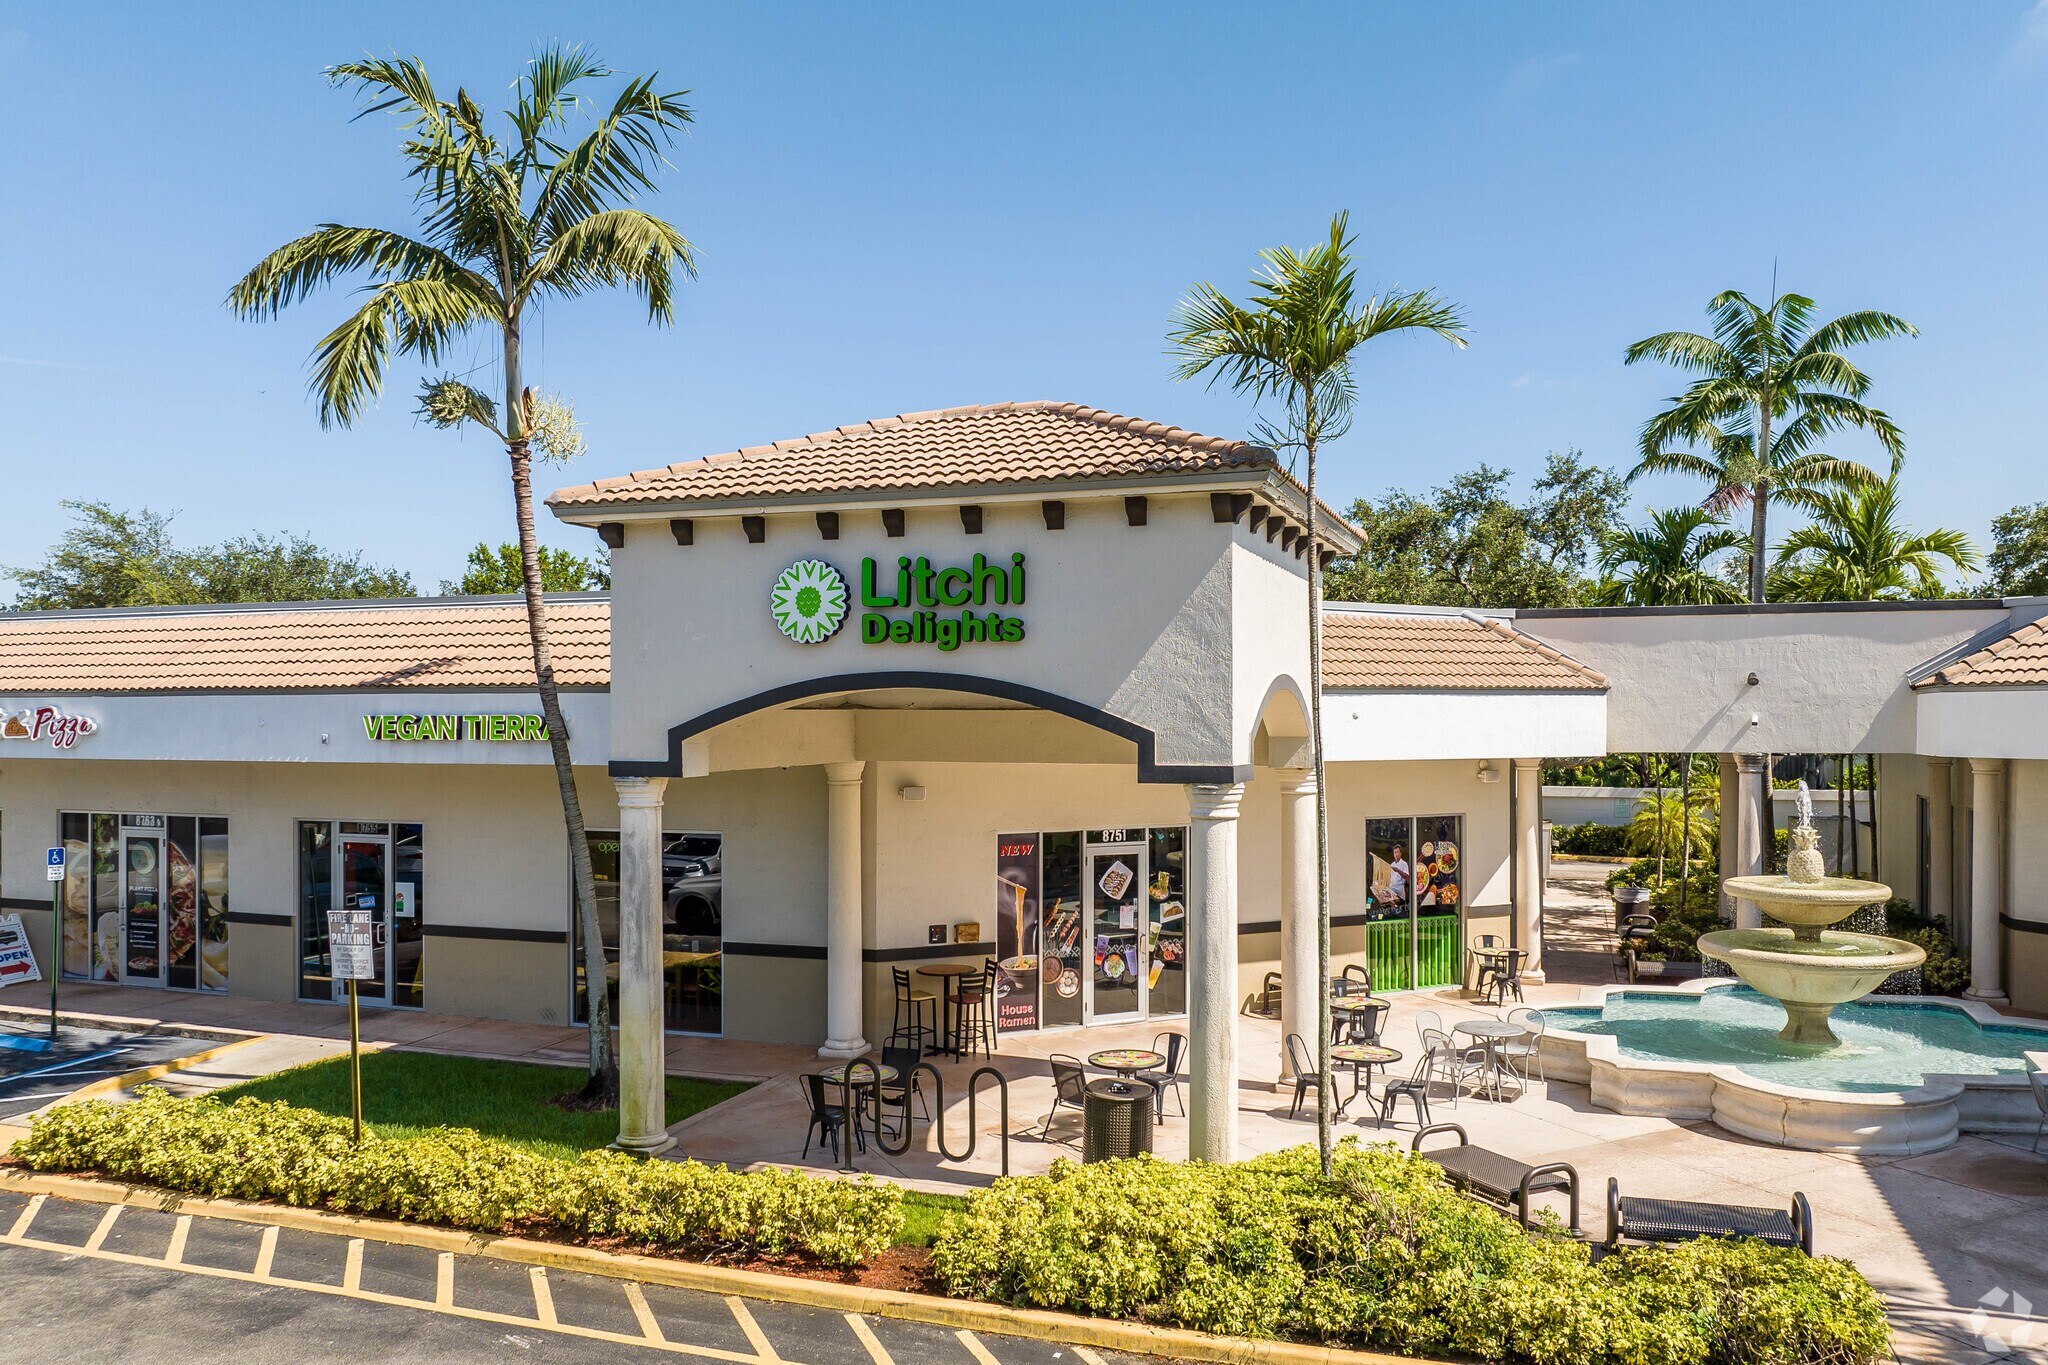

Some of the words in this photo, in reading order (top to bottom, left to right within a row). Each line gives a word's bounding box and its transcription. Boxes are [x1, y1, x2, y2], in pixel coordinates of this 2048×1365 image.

[861, 552, 1025, 607] Litchi
[861, 609, 1025, 651] Delights
[32, 707, 93, 748] Pizza
[363, 714, 458, 741] VEGAN
[135, 815, 155, 827] 8763
[1102, 829, 1127, 842] 8751
[598, 842, 620, 854] ope
[1000, 844, 1035, 857] NEW
[329, 913, 346, 923] FIRE
[349, 913, 370, 924] LANE
[331, 933, 370, 945] PARKING
[1001, 1005, 1034, 1016] House
[998, 1016, 1036, 1028] Ramen
